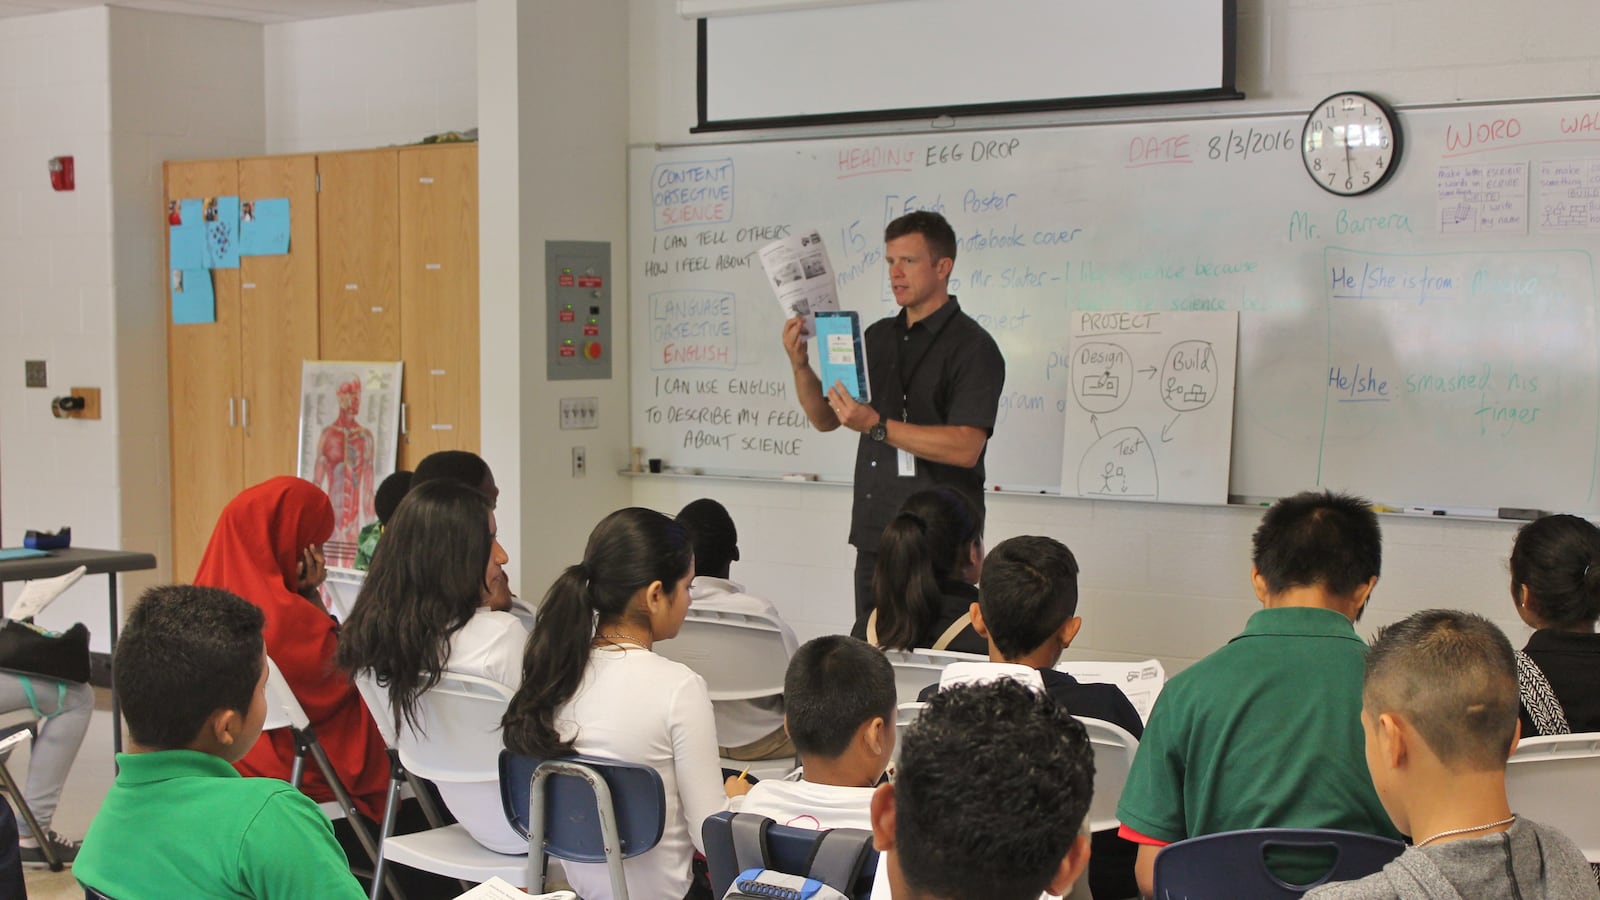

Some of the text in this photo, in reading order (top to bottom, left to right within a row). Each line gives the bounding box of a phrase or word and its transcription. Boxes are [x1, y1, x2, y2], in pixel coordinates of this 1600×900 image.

[1326, 105, 1336, 118] 11
[1341, 97, 1355, 111] 12
[1311, 120, 1323, 132] 10
[1446, 112, 1600, 151] WORD WAL
[837, 138, 1020, 170] HEADING EGG DROP
[1128, 128, 1295, 163] DATE 8/3/2016
[1381, 136, 1390, 150] 3
[1313, 158, 1322, 171] 8
[1375, 155, 1384, 169] 4
[658, 165, 729, 189] CONTENT
[1328, 172, 1336, 186] 7
[1345, 176, 1353, 190] 6
[1362, 171, 1370, 185] 5
[655, 185, 730, 207] OBJECTIVE
[963, 188, 1017, 213] Poster
[662, 204, 723, 224] SCIENCE
[1336, 208, 1414, 235] Barrera
[664, 235, 688, 251] CAN
[697, 230, 727, 246] TELL
[736, 224, 792, 241] OTHERS
[841, 220, 867, 256] 15
[1033, 227, 1082, 246] cover
[645, 261, 668, 276] HOW
[682, 256, 711, 271] FEEL
[715, 251, 757, 270] ABOUT
[1194, 255, 1259, 277] because
[1402, 272, 1416, 289] is
[655, 297, 730, 320] LANGUAGE
[655, 320, 731, 342] OBJECTIVE
[1081, 312, 1160, 332] PROJECT
[663, 343, 728, 364] ENGLISH
[1081, 349, 1124, 371] Design
[1173, 345, 1211, 373] Build
[655, 376, 786, 400] I CAN USE ENGLISH
[1406, 363, 1493, 393] smashed
[1507, 365, 1538, 393] his
[645, 406, 662, 424] TO
[667, 406, 732, 425] DESCRIBE
[738, 408, 760, 426] MY
[999, 391, 1045, 424] gram
[1475, 392, 1542, 441] finger
[683, 430, 803, 456] ABOUT SCIENCE
[1113, 438, 1145, 456] Test
